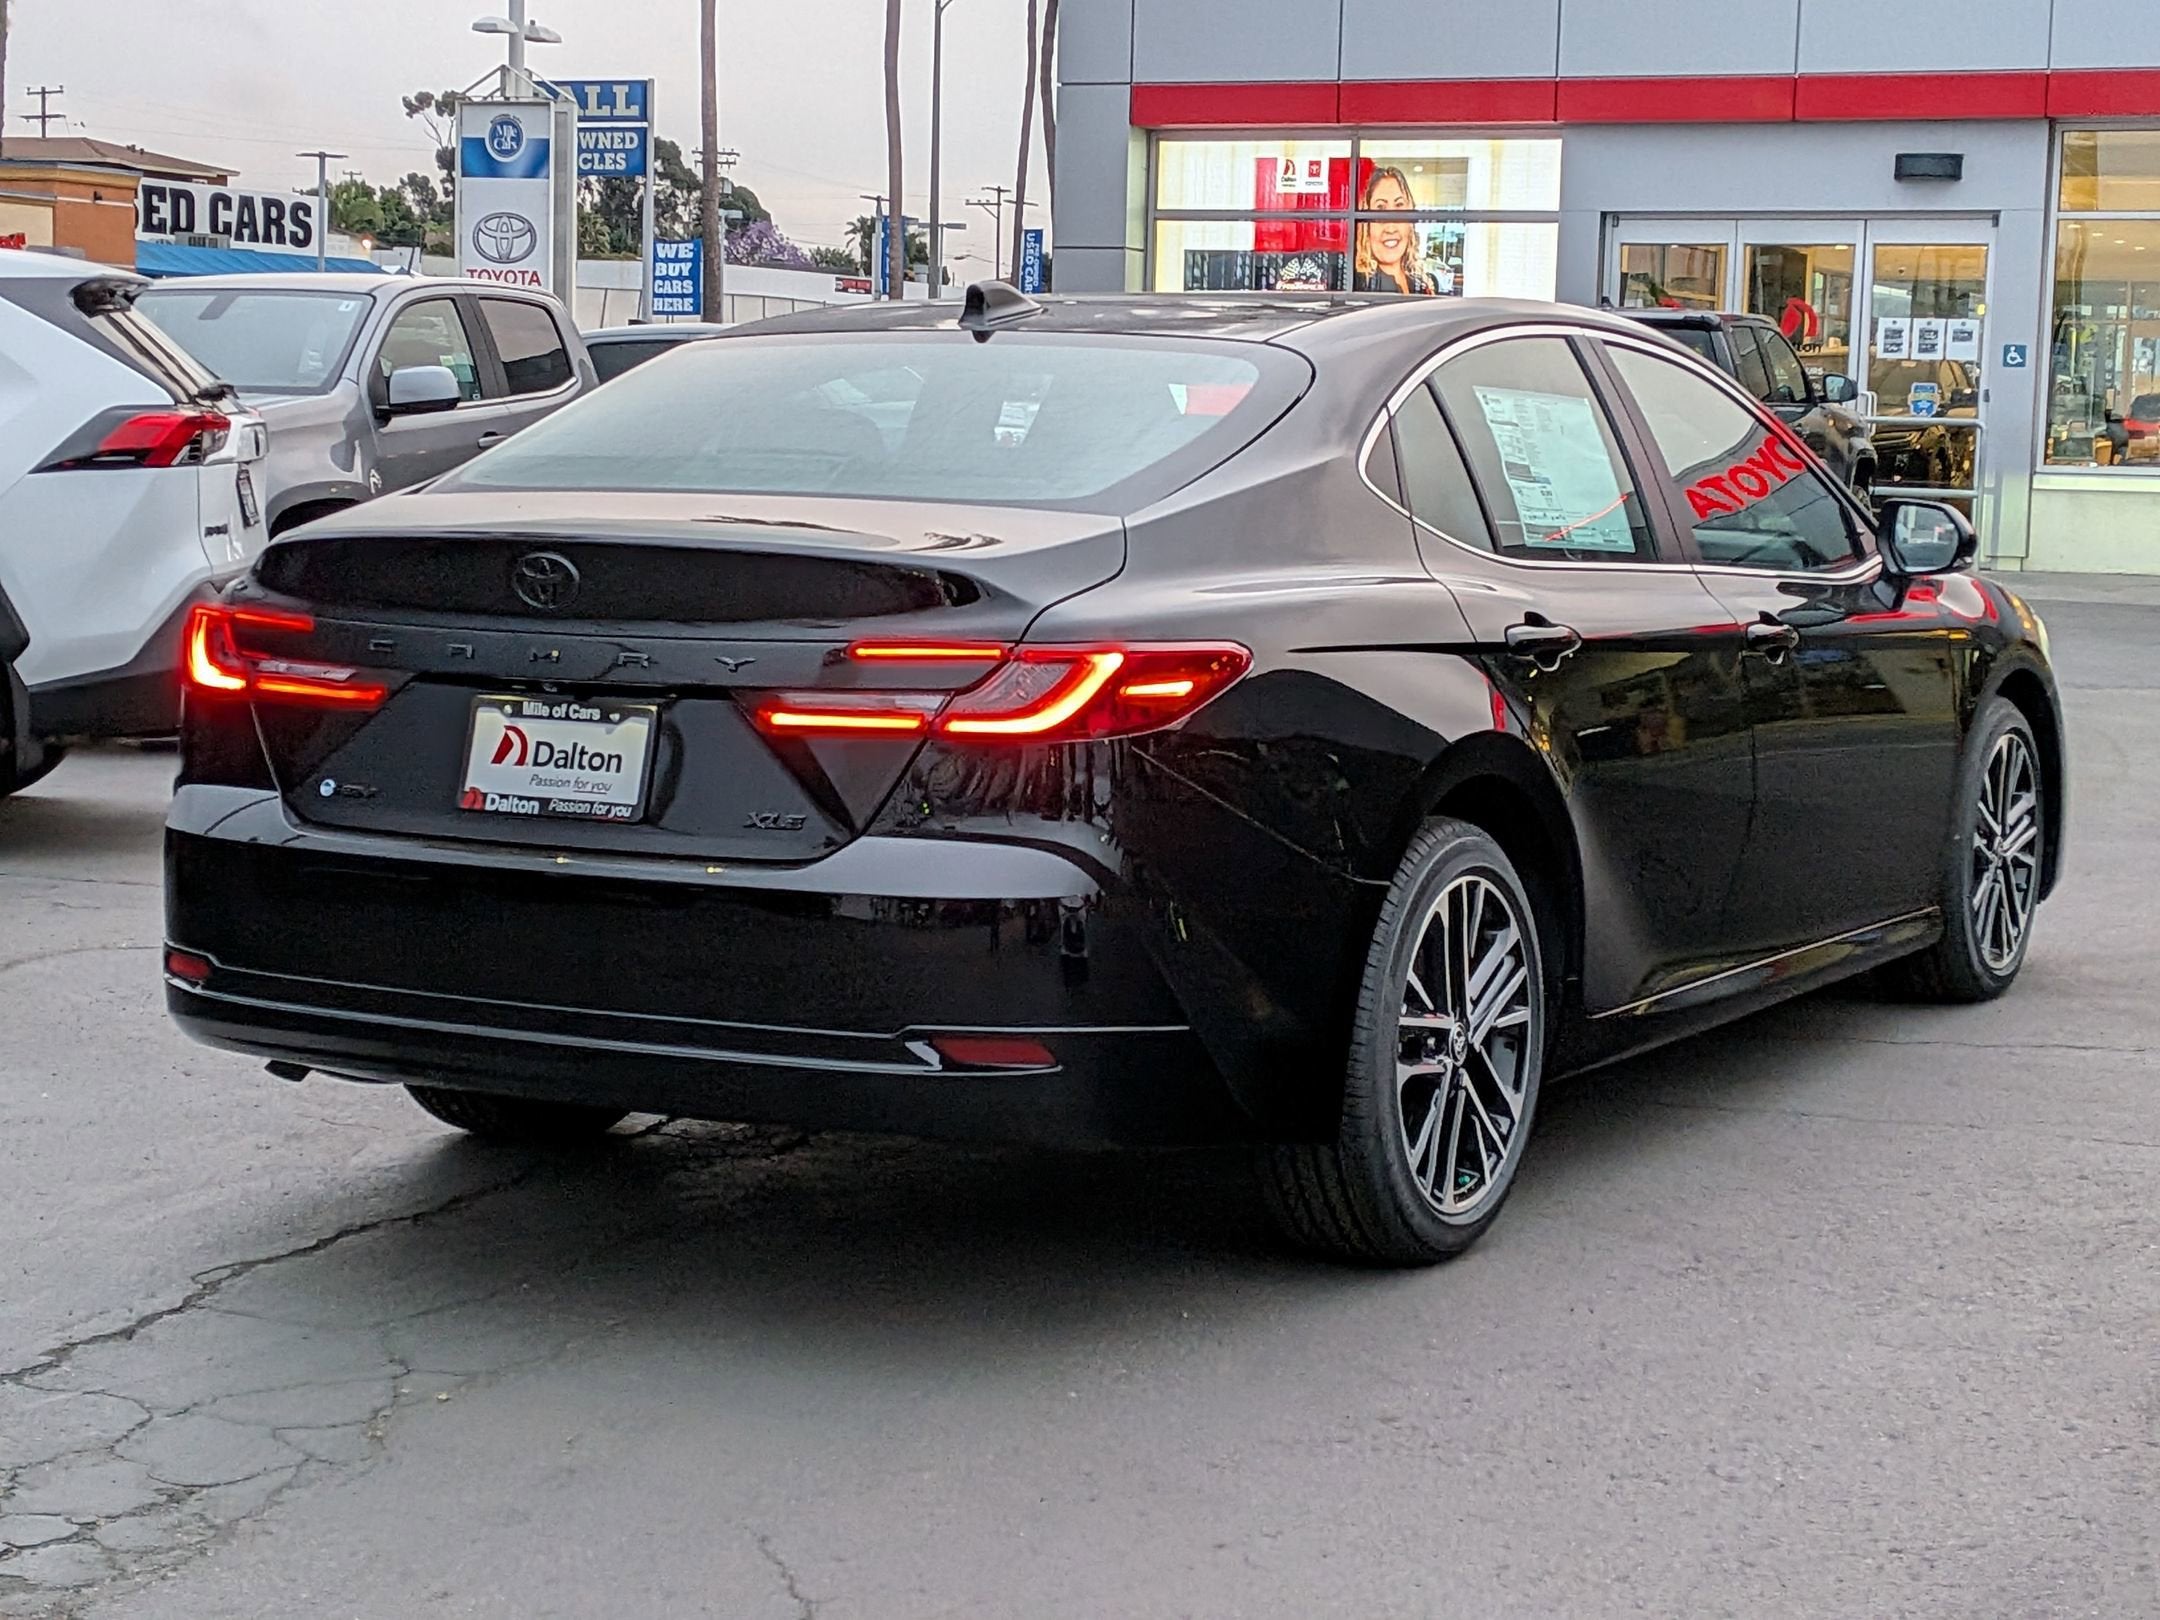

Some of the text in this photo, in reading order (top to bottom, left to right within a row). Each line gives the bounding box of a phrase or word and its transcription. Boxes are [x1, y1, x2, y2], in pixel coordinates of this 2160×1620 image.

[208, 192, 312, 249] CARS
[655, 243, 695, 259] WE
[1025, 232, 1036, 265] USED
[466, 268, 542, 287] TOYOTA
[654, 262, 693, 277] BUY
[653, 279, 694, 294] CARS
[652, 297, 694, 312] HERE
[368, 638, 757, 673] CAMRY
[522, 701, 601, 721] Mile of Cars
[532, 741, 622, 773] Dalton
[529, 773, 613, 793] Passion for you
[484, 793, 633, 818] Dalton Passion for you
